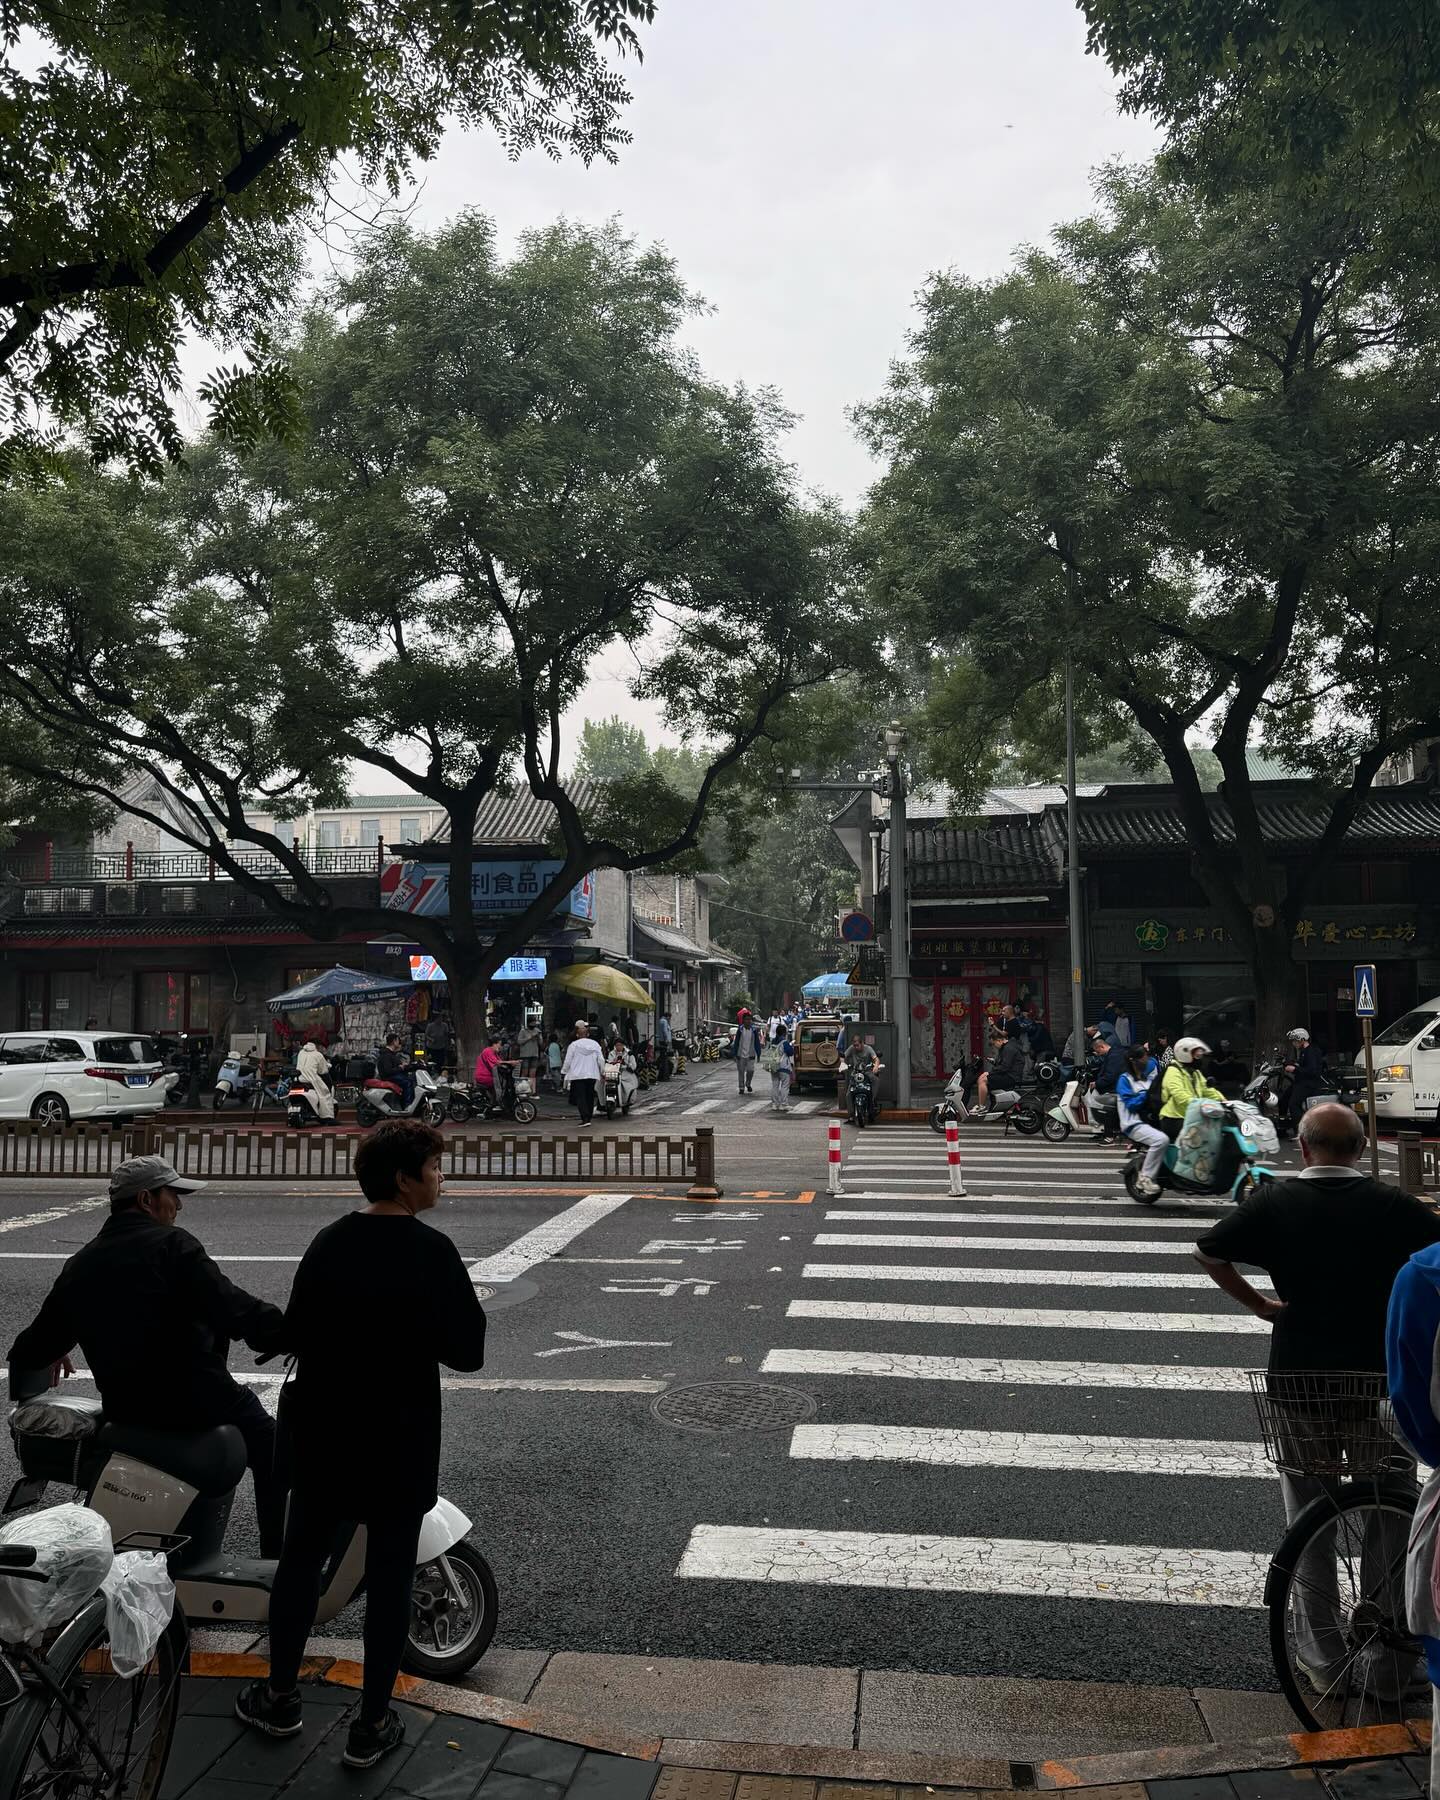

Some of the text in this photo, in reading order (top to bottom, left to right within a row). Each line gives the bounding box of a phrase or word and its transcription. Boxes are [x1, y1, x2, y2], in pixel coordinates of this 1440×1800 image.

[444, 871, 562, 895] 利食品
[1175, 927, 1233, 944] 东华门
[502, 959, 538, 973] 服装
